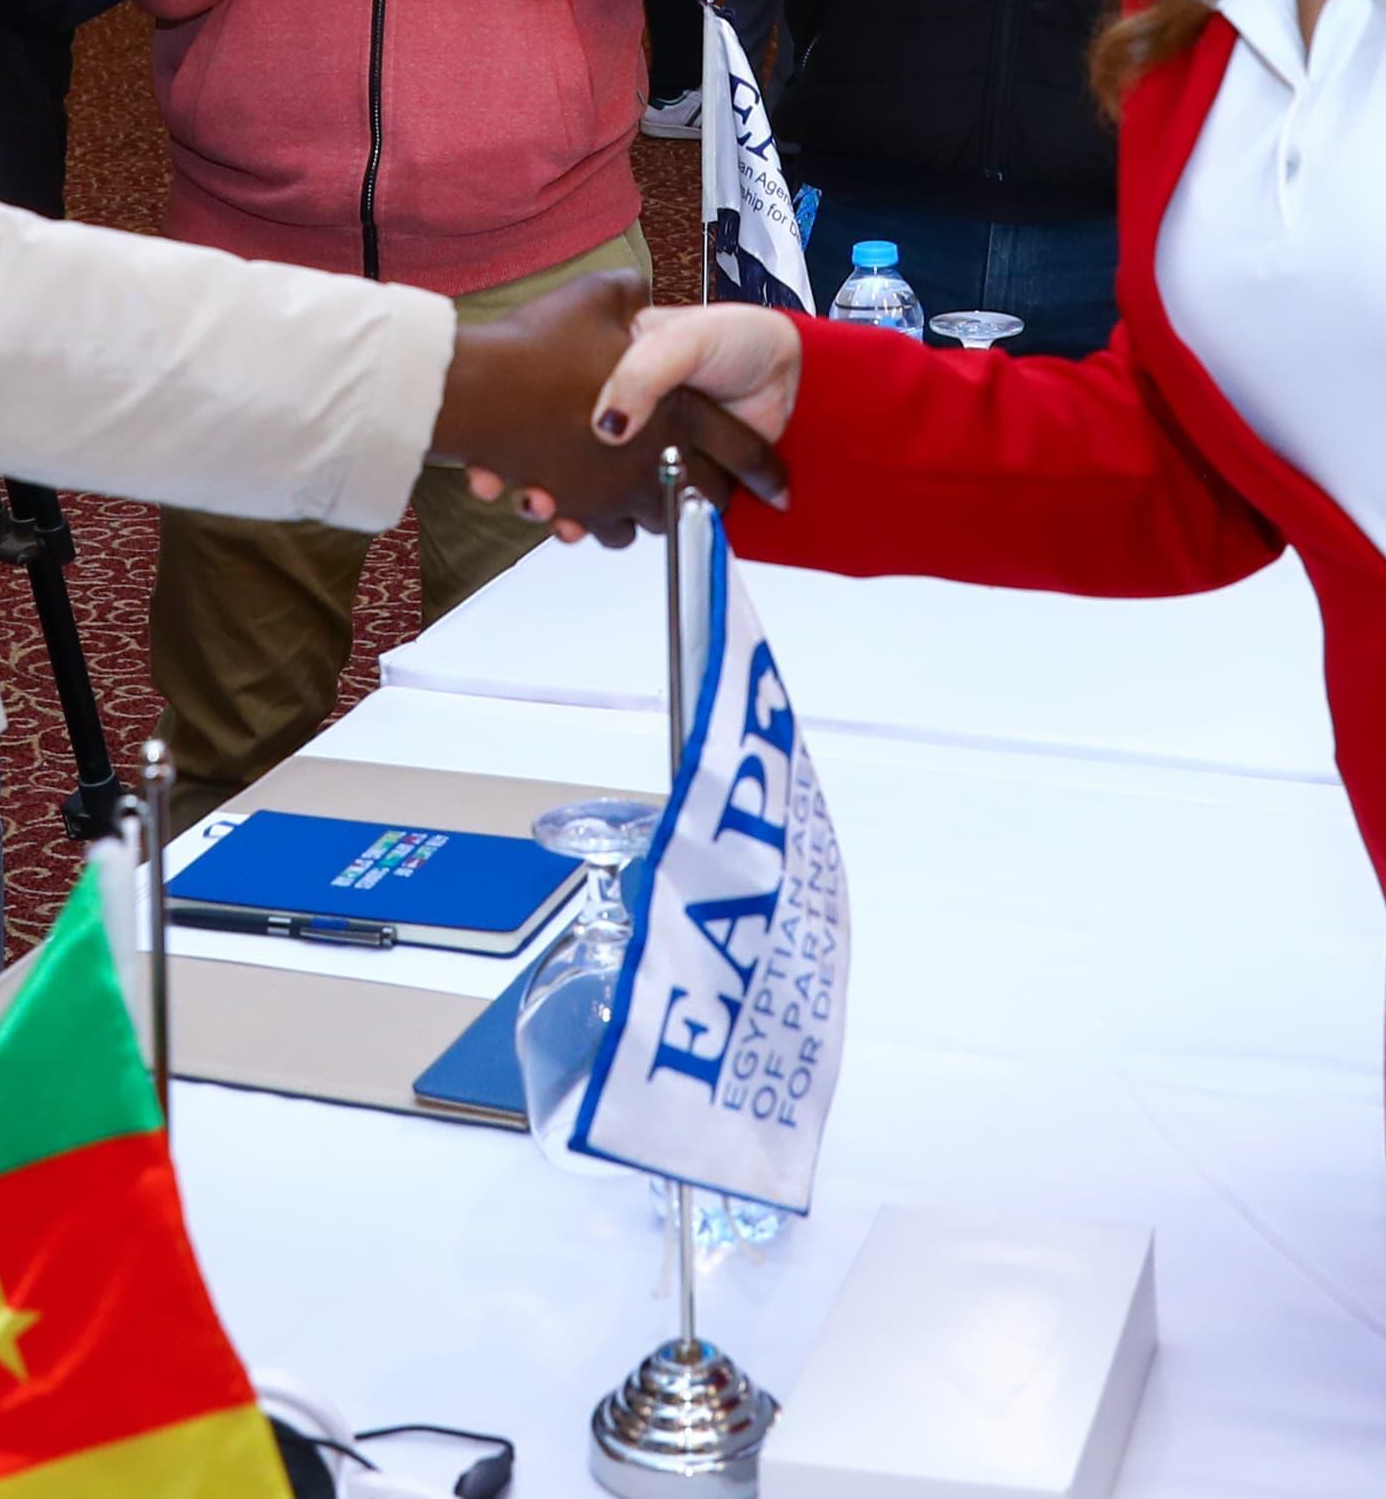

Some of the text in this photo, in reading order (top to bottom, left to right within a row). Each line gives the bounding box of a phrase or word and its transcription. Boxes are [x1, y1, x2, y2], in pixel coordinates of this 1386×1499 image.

[766, 203, 788, 225] for
[723, 876, 803, 1111] EGYPTIAN
[752, 1052, 785, 1119] OF
[778, 1034, 823, 1129] FOR
